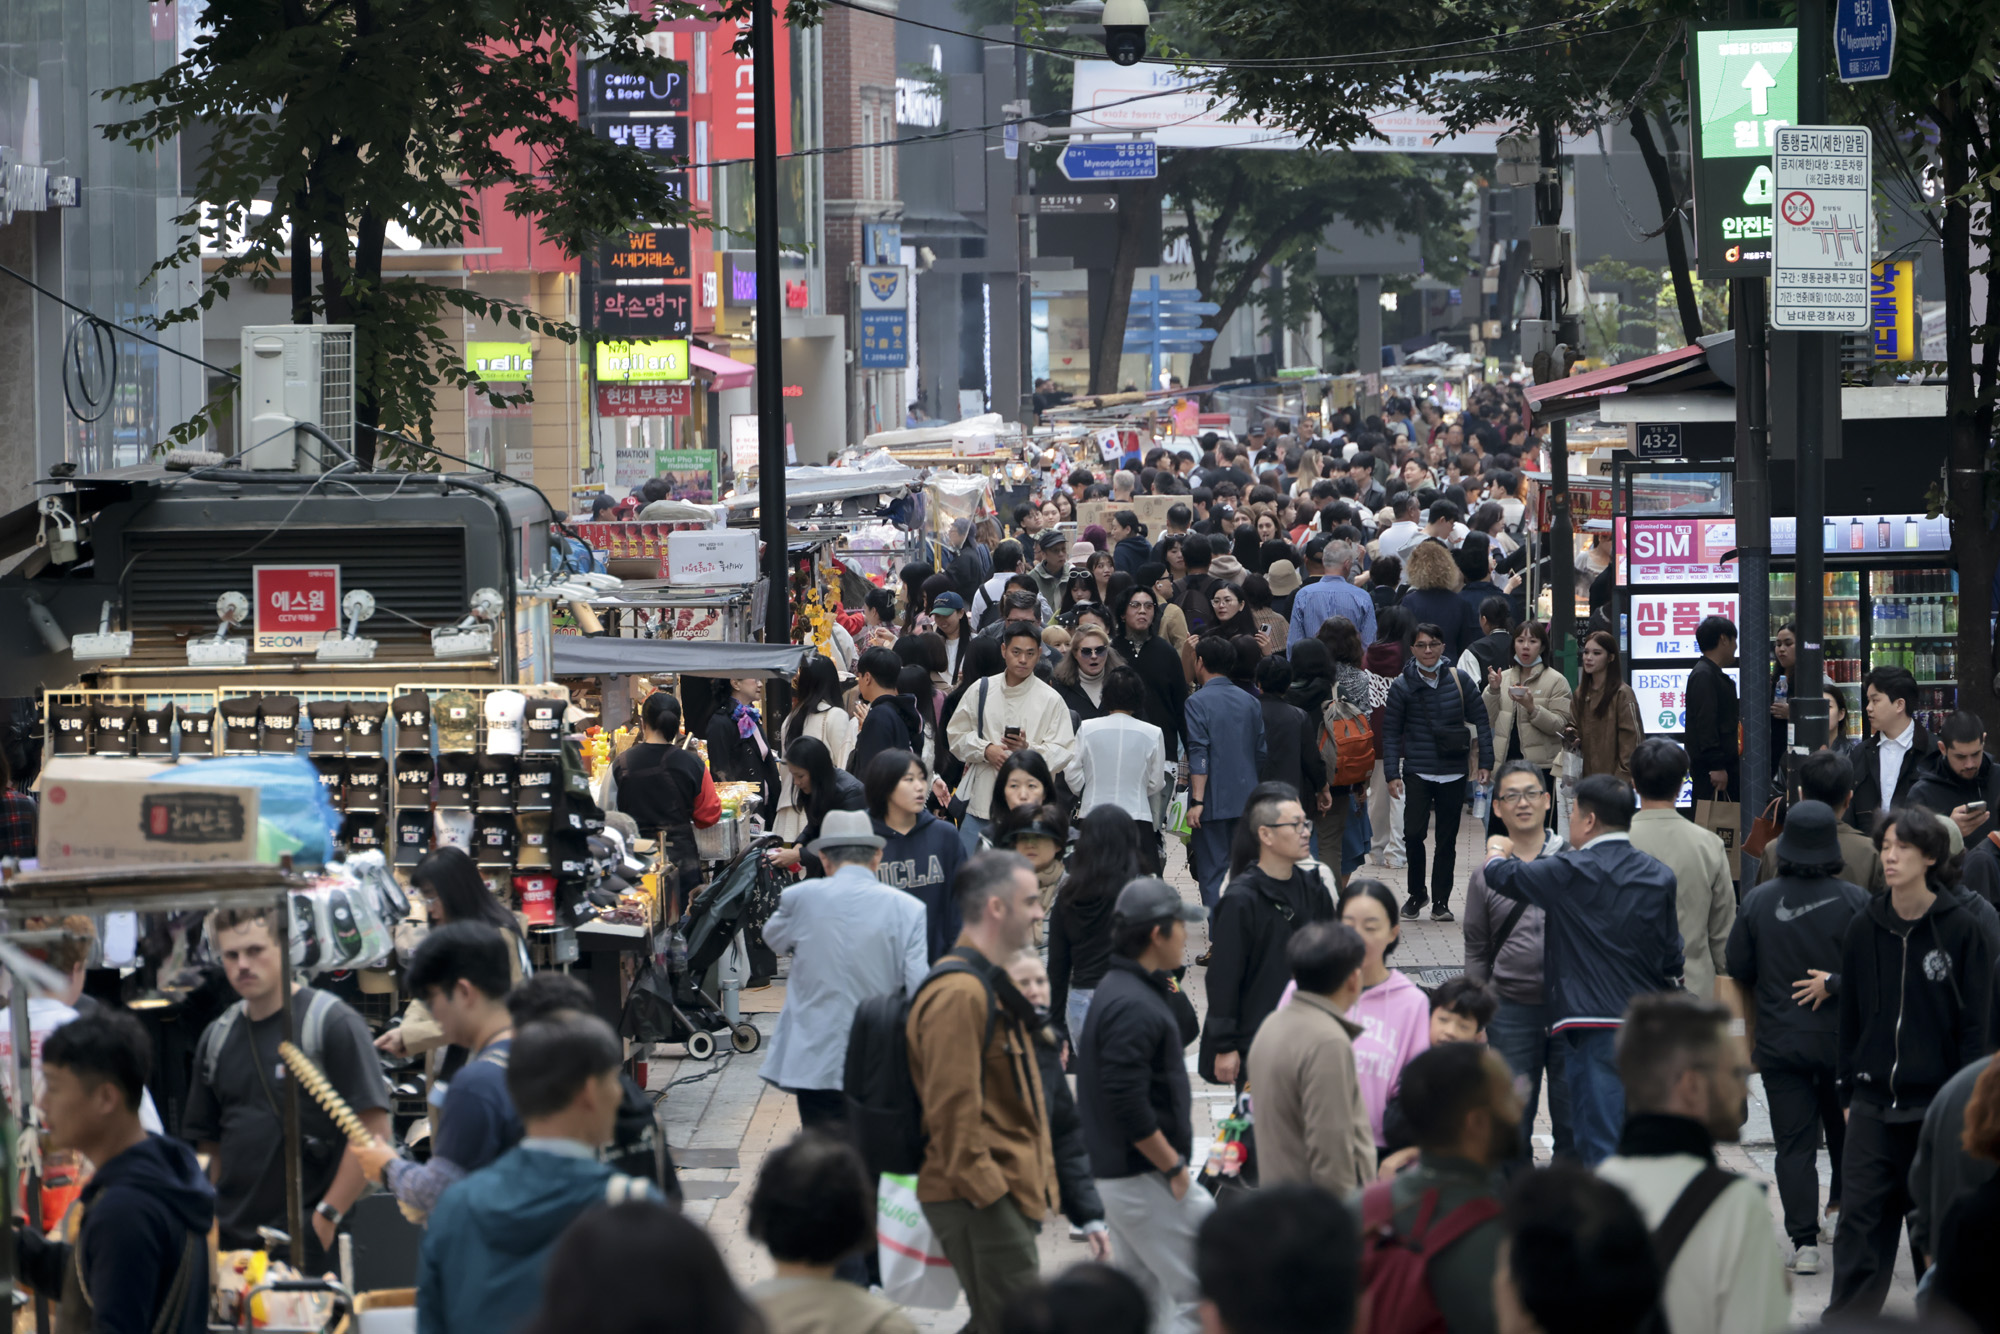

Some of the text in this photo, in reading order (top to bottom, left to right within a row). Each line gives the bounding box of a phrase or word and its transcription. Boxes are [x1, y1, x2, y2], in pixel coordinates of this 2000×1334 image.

[617, 88, 646, 99] Beer
[1781, 134, 1864, 154] 통행금지(제한)알림
[629, 232, 656, 250] WE
[611, 252, 675, 268] 시계거래소
[1801, 272, 1847, 284] 명동관광특구
[604, 292, 687, 318] 약손명가
[1787, 311, 1855, 322] 남대문경찰서장
[609, 354, 676, 370] nail art
[607, 388, 684, 405] 현대 부동산
[1642, 434, 1677, 448] 43-2
[1634, 531, 1690, 558] SIM
[271, 590, 325, 611] 에스원
[278, 614, 296, 622] CCTV
[673, 627, 710, 638] arbecue
[259, 636, 303, 647] SECOM
[1656, 641, 1680, 653] 사고
[1638, 675, 1682, 688] BEST
[59, 718, 82, 731] 엄마
[100, 717, 124, 730] 아빠
[401, 711, 424, 726] 서울
[356, 720, 372, 735] 왕
[399, 770, 429, 783] 사장님
[443, 772, 467, 786] 대장
[483, 772, 508, 786] 최고
[439, 827, 466, 836] KOREA
[876, 854, 945, 889] UCLA
